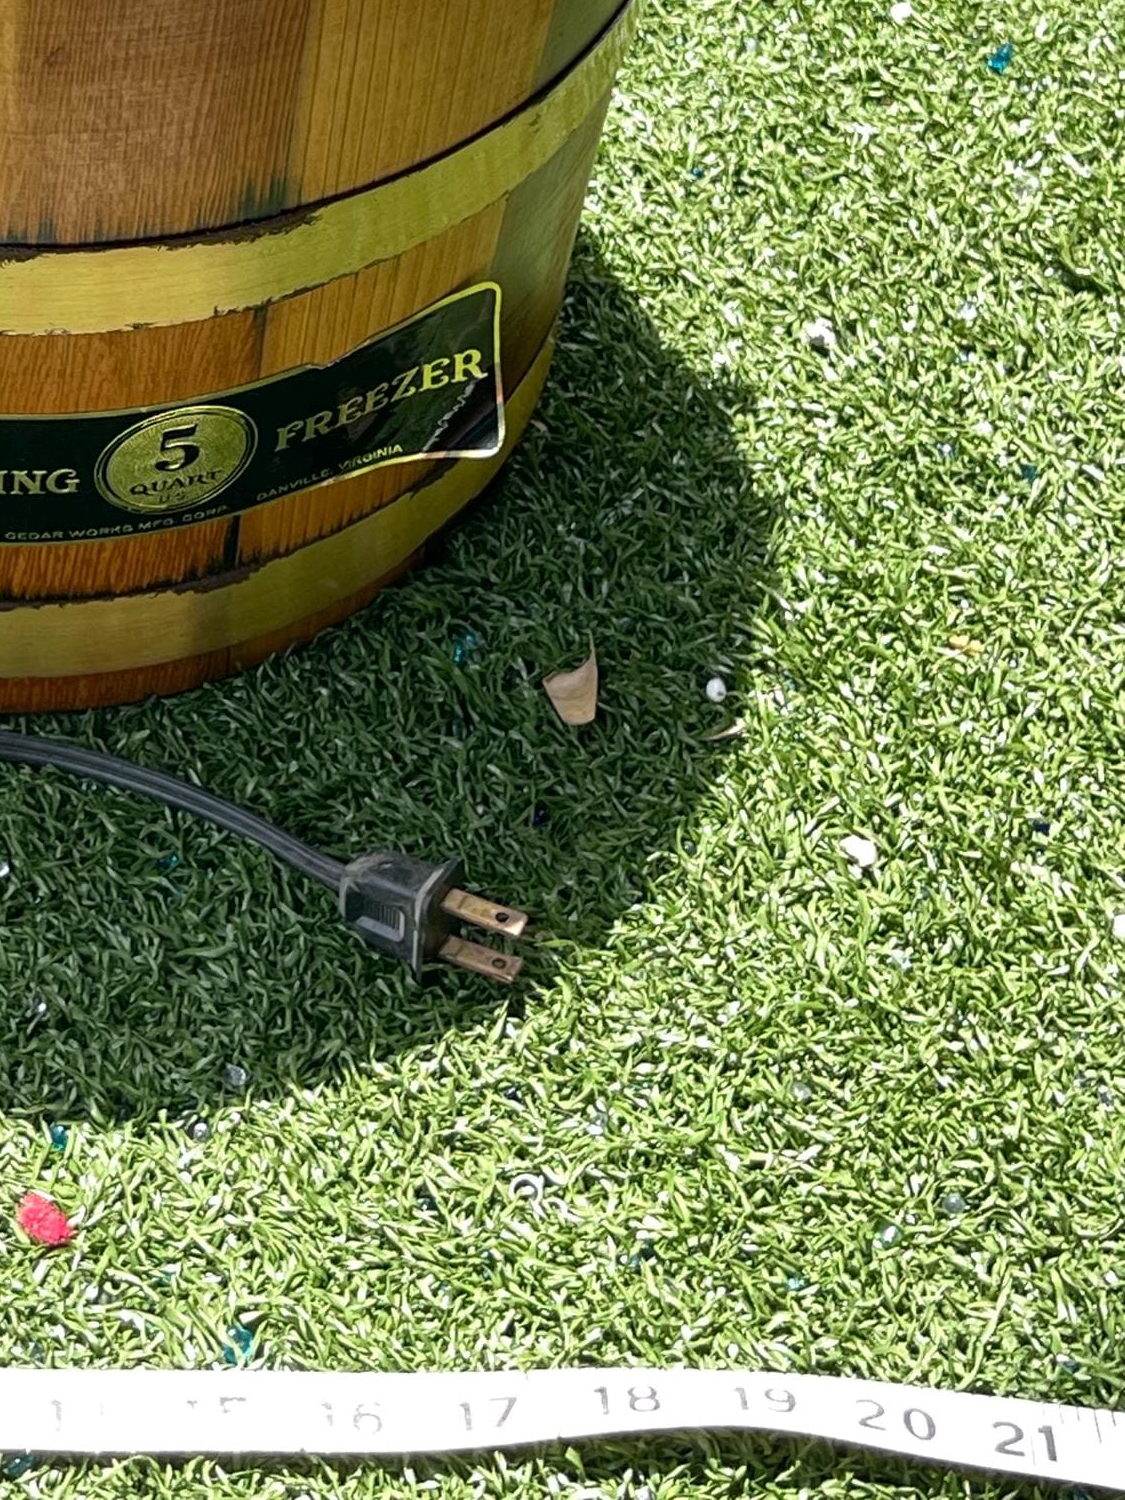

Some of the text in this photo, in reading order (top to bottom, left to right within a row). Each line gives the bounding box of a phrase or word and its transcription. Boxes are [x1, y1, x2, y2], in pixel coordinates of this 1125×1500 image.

[275, 348, 489, 451] FREEZER
[154, 422, 201, 473] 5
[339, 443, 404, 470] VIRGINIA
[129, 469, 222, 496] QUART
[3, 529, 64, 540] CEDAR
[69, 523, 135, 539] WORKS
[460, 1396, 517, 1431] 17
[594, 1386, 662, 1416] 18
[734, 1386, 798, 1414] 19
[855, 1398, 937, 1441] 20
[992, 1420, 1058, 1462] 21
